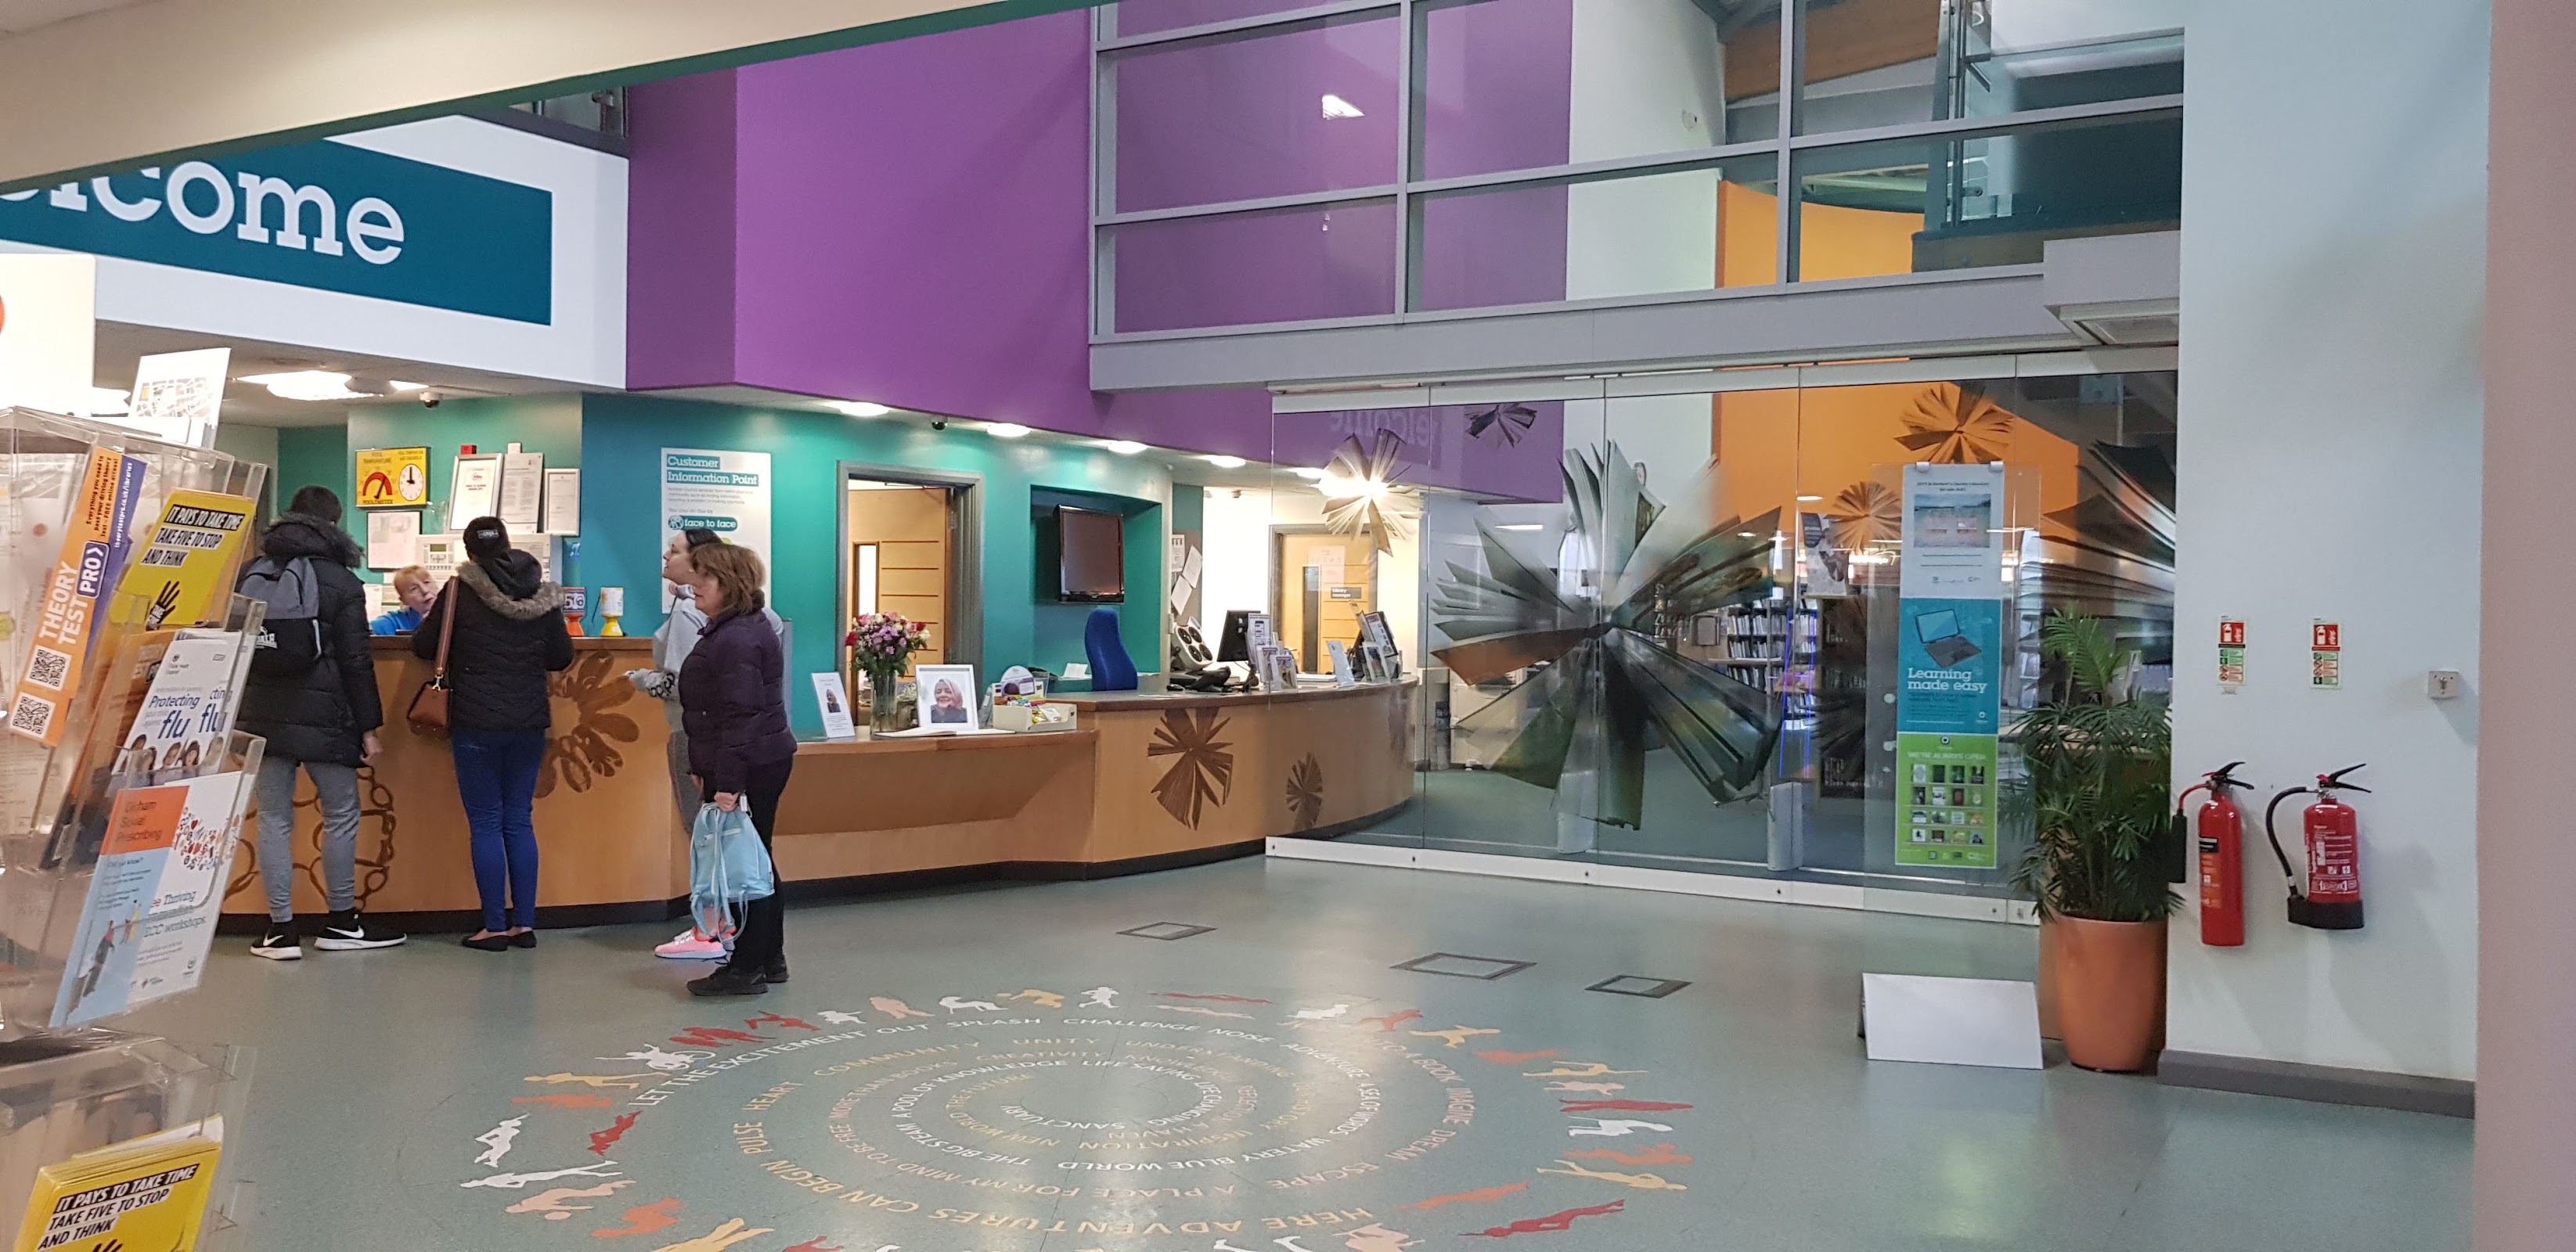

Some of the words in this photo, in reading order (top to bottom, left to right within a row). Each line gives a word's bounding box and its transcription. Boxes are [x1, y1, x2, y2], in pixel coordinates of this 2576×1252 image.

[0, 161, 405, 264] come
[668, 456, 719, 468] Customer
[668, 471, 730, 484] Information
[732, 474, 758, 484] Point
[166, 505, 179, 522] IT
[178, 507, 197, 525] PAYS
[195, 510, 208, 527] TO
[204, 512, 227, 529] TAKE
[225, 514, 244, 531] TIME
[684, 518, 704, 527] face
[706, 519, 715, 527] to
[716, 520, 737, 528] face
[154, 527, 179, 544] TAKE
[174, 530, 196, 546] FIVE
[191, 531, 206, 547] TO
[200, 534, 223, 549] STOP
[141, 549, 164, 564] AND
[160, 550, 189, 567] THINK
[38, 561, 77, 638] THEORY
[58, 595, 88, 645] TEST
[1908, 667, 1972, 682] Learning
[1908, 680, 1950, 690] made
[1953, 682, 1987, 693] easy
[149, 694, 200, 709] Protecting
[157, 711, 191, 739] flu
[877, 1024, 929, 1034] OUT
[946, 1019, 1041, 1027] SPLASH
[1063, 1018, 1201, 1031] CHALLENGE
[1209, 1028, 1275, 1044] NOISE
[712, 1031, 866, 1070] EXCITEMENT
[814, 1042, 978, 1076] COMMUNITY
[894, 1061, 958, 1078] BOOKS
[937, 1060, 1068, 1083] KNOWLEDGE
[1279, 1044, 1371, 1080] ADVENTURE
[1412, 1059, 1465, 1082] BOOK
[661, 1069, 719, 1086] THE
[1132, 1063, 1201, 1081] SAVING
[744, 1081, 804, 1111] HEART
[847, 1078, 895, 1096] THAN
[913, 1082, 937, 1092] OF
[628, 1088, 675, 1106] LET
[892, 1095, 923, 1113] POOL
[1443, 1088, 1475, 1125] IMAGINE
[829, 1097, 859, 1118] MORE
[1000, 1105, 1126, 1129] SANCTUARY
[949, 1112, 1004, 1136] WORLD
[1330, 1110, 1378, 1135] WORDS
[733, 1121, 773, 1155] PULSE
[829, 1123, 858, 1142] FREE
[896, 1123, 950, 1148] STEAM
[1002, 1134, 1061, 1147] NEW
[1079, 1129, 1253, 1149] INSPIRATION
[846, 1142, 876, 1153] BE
[942, 1146, 983, 1158] BIG
[1241, 1139, 1331, 1162] WATERY
[1385, 1129, 1457, 1160] DREAM
[867, 1153, 899, 1164] TO
[980, 1154, 1031, 1165] THE
[1058, 1161, 1162, 1171] WORLD
[1168, 1157, 1235, 1170] BLUE
[760, 1160, 844, 1193] BEGIN
[896, 1163, 963, 1181] MIND
[1266, 1161, 1380, 1189] ESCAPE
[57, 1197, 73, 1212] IT
[73, 1188, 111, 1207] PAYS
[111, 1185, 129, 1198] TO
[131, 1175, 163, 1193] TAKE
[164, 1166, 197, 1185] TIME
[962, 1178, 1008, 1189] MY
[1012, 1185, 1081, 1196] FOR
[1093, 1187, 1204, 1198] PLACE
[1214, 1185, 1235, 1195] A
[49, 1212, 85, 1230] TAKE
[85, 1202, 117, 1221] FIVE
[117, 1198, 135, 1213] TO
[135, 1188, 170, 1208] STOP
[838, 1189, 919, 1212] CAN
[928, 1208, 1242, 1235] ADVENTURES
[1262, 1207, 1374, 1229] HERE
[38, 1232, 71, 1250] AND
[73, 1218, 117, 1241] THINK
